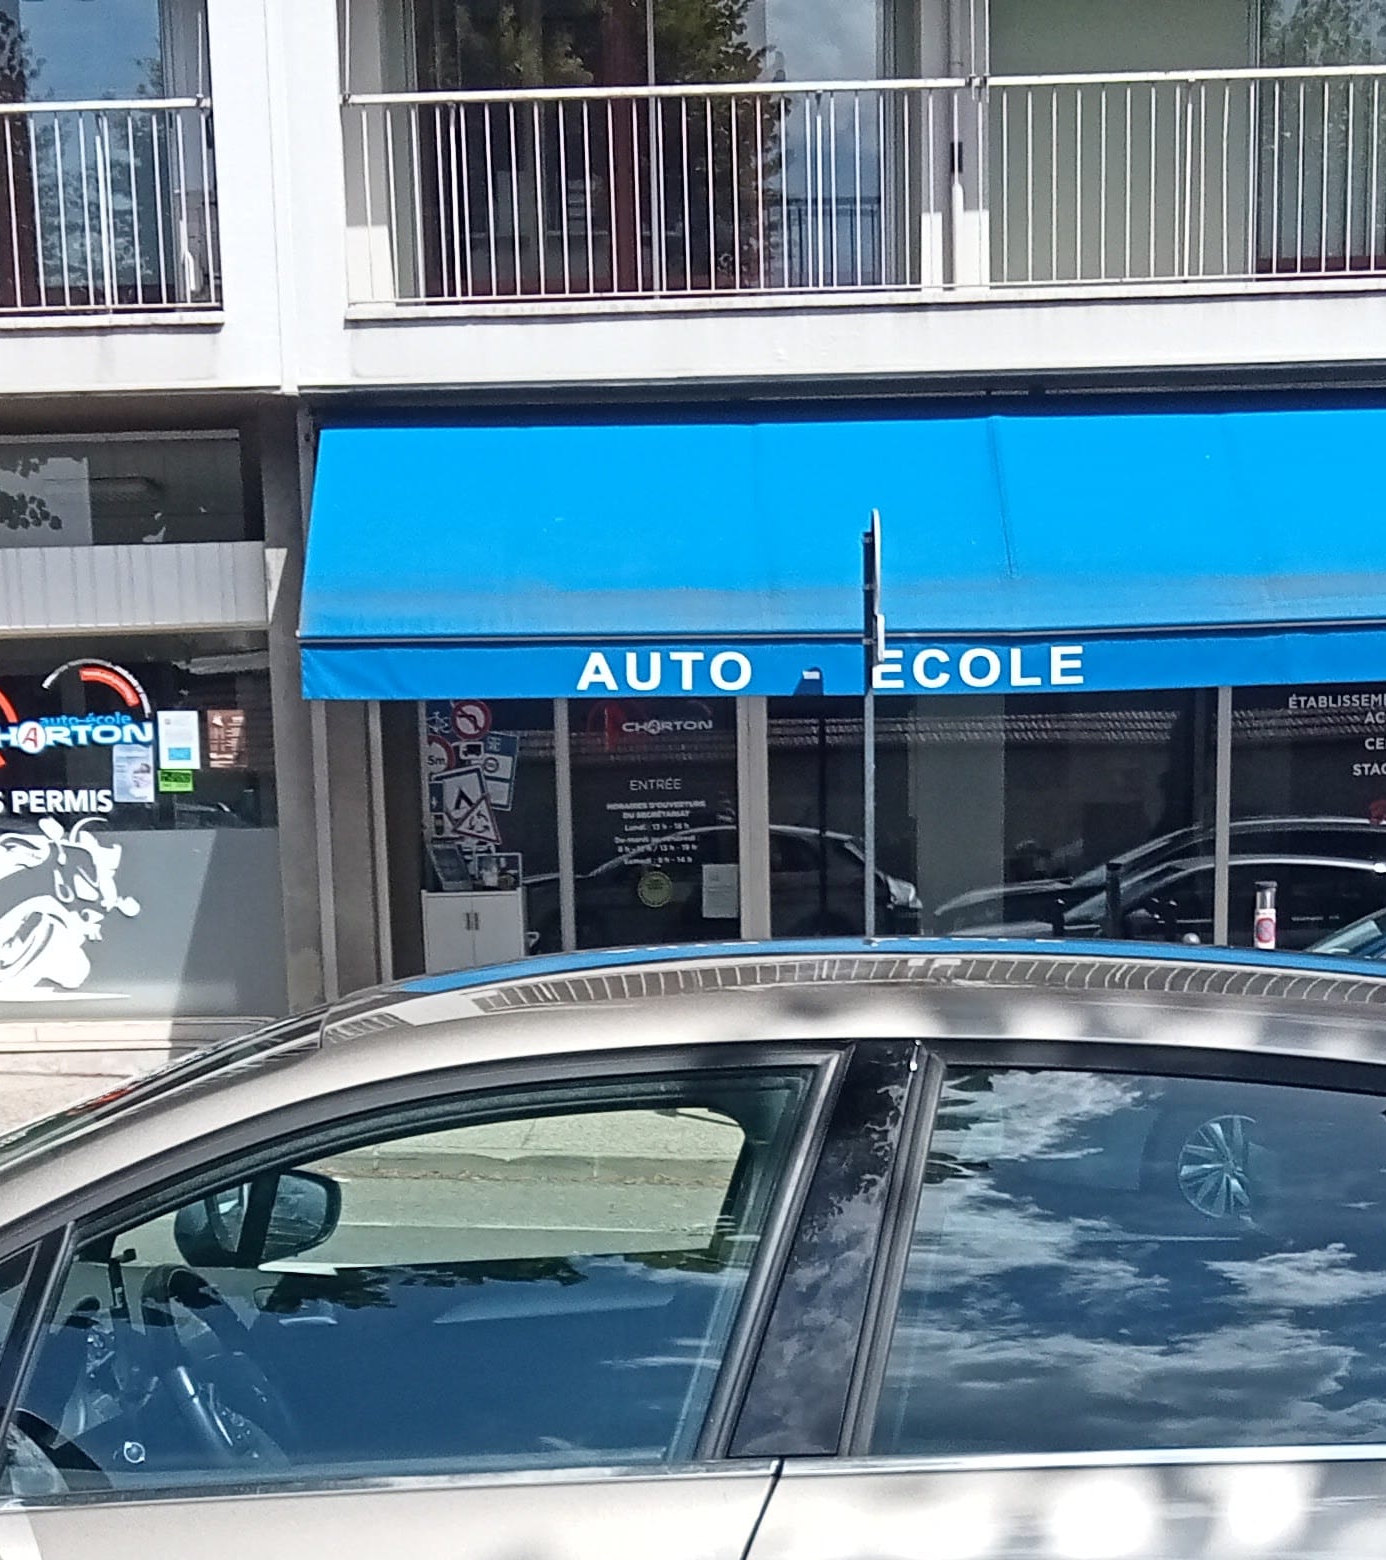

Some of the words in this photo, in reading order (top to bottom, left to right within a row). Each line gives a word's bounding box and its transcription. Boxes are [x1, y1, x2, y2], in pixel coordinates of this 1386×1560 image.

[576, 651, 752, 691] AUTO
[872, 645, 1085, 689] ECOLE
[621, 720, 713, 735] CHARTON
[629, 777, 682, 791] ENTRÉE
[12, 789, 114, 815] PERMIS
